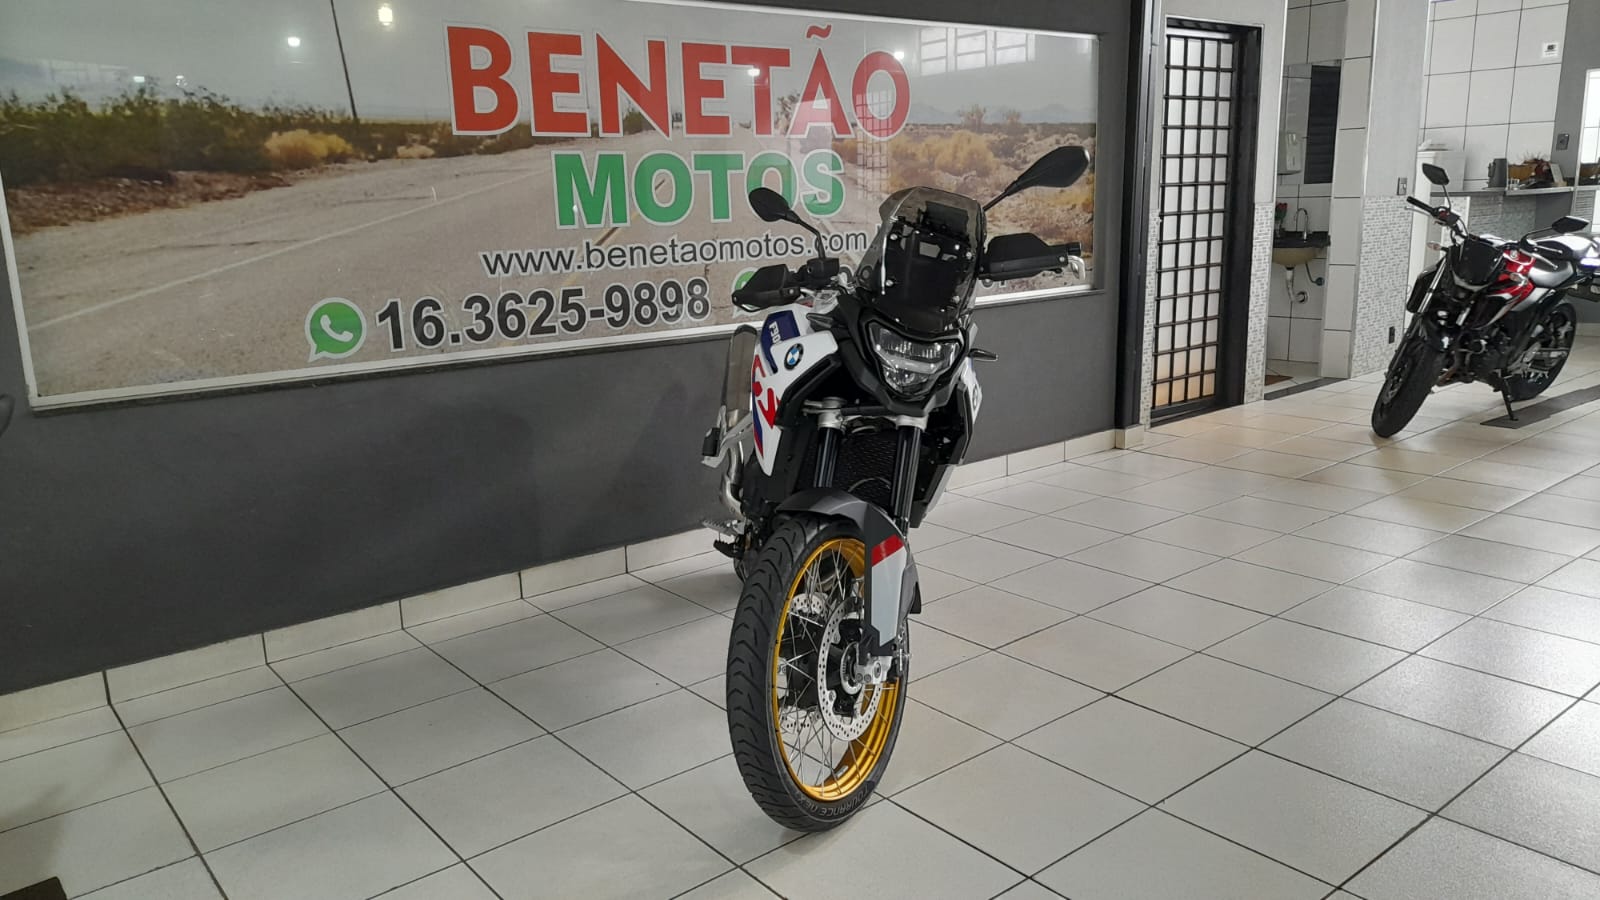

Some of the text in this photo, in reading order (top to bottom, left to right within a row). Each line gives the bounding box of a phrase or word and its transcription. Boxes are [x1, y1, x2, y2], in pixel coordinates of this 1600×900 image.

[445, 24, 911, 138] BENETÃO
[554, 150, 845, 229] MOTOS
[376, 278, 710, 351] 16.3625-9898
